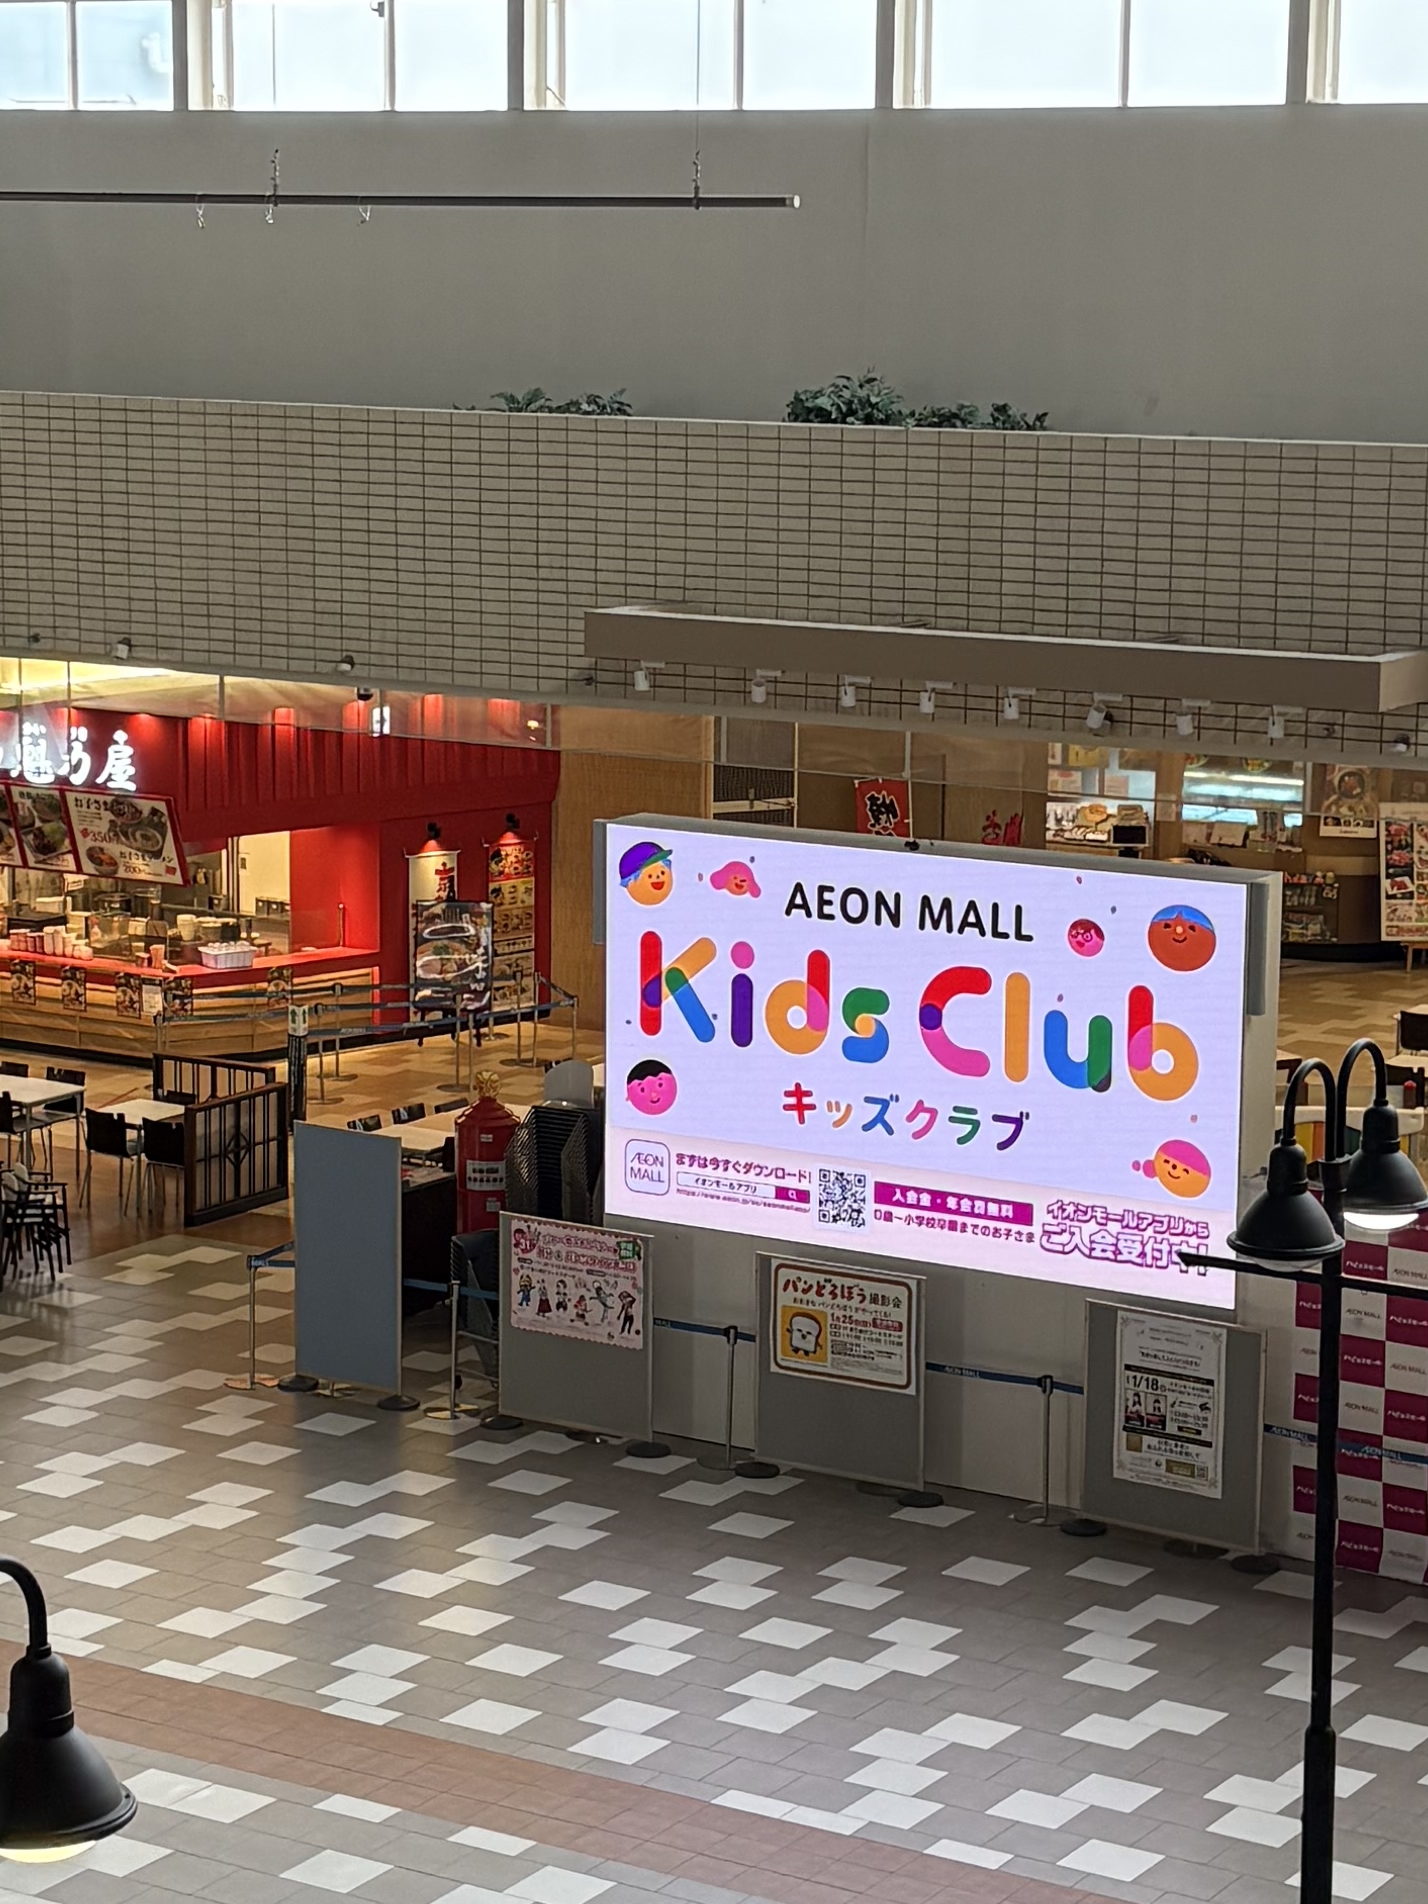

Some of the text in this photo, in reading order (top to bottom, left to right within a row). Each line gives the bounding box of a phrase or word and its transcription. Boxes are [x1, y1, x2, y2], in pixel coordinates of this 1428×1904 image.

[785, 881, 1034, 943] AEON MALL
[639, 930, 891, 1064] Kids
[918, 965, 1199, 1101] Club
[782, 1081, 1030, 1152] キッズクラブ
[629, 1165, 666, 1184] MALL
[1046, 1199, 1210, 1240] イオンモールアプリから
[782, 1275, 867, 1305] パンどろぼう
